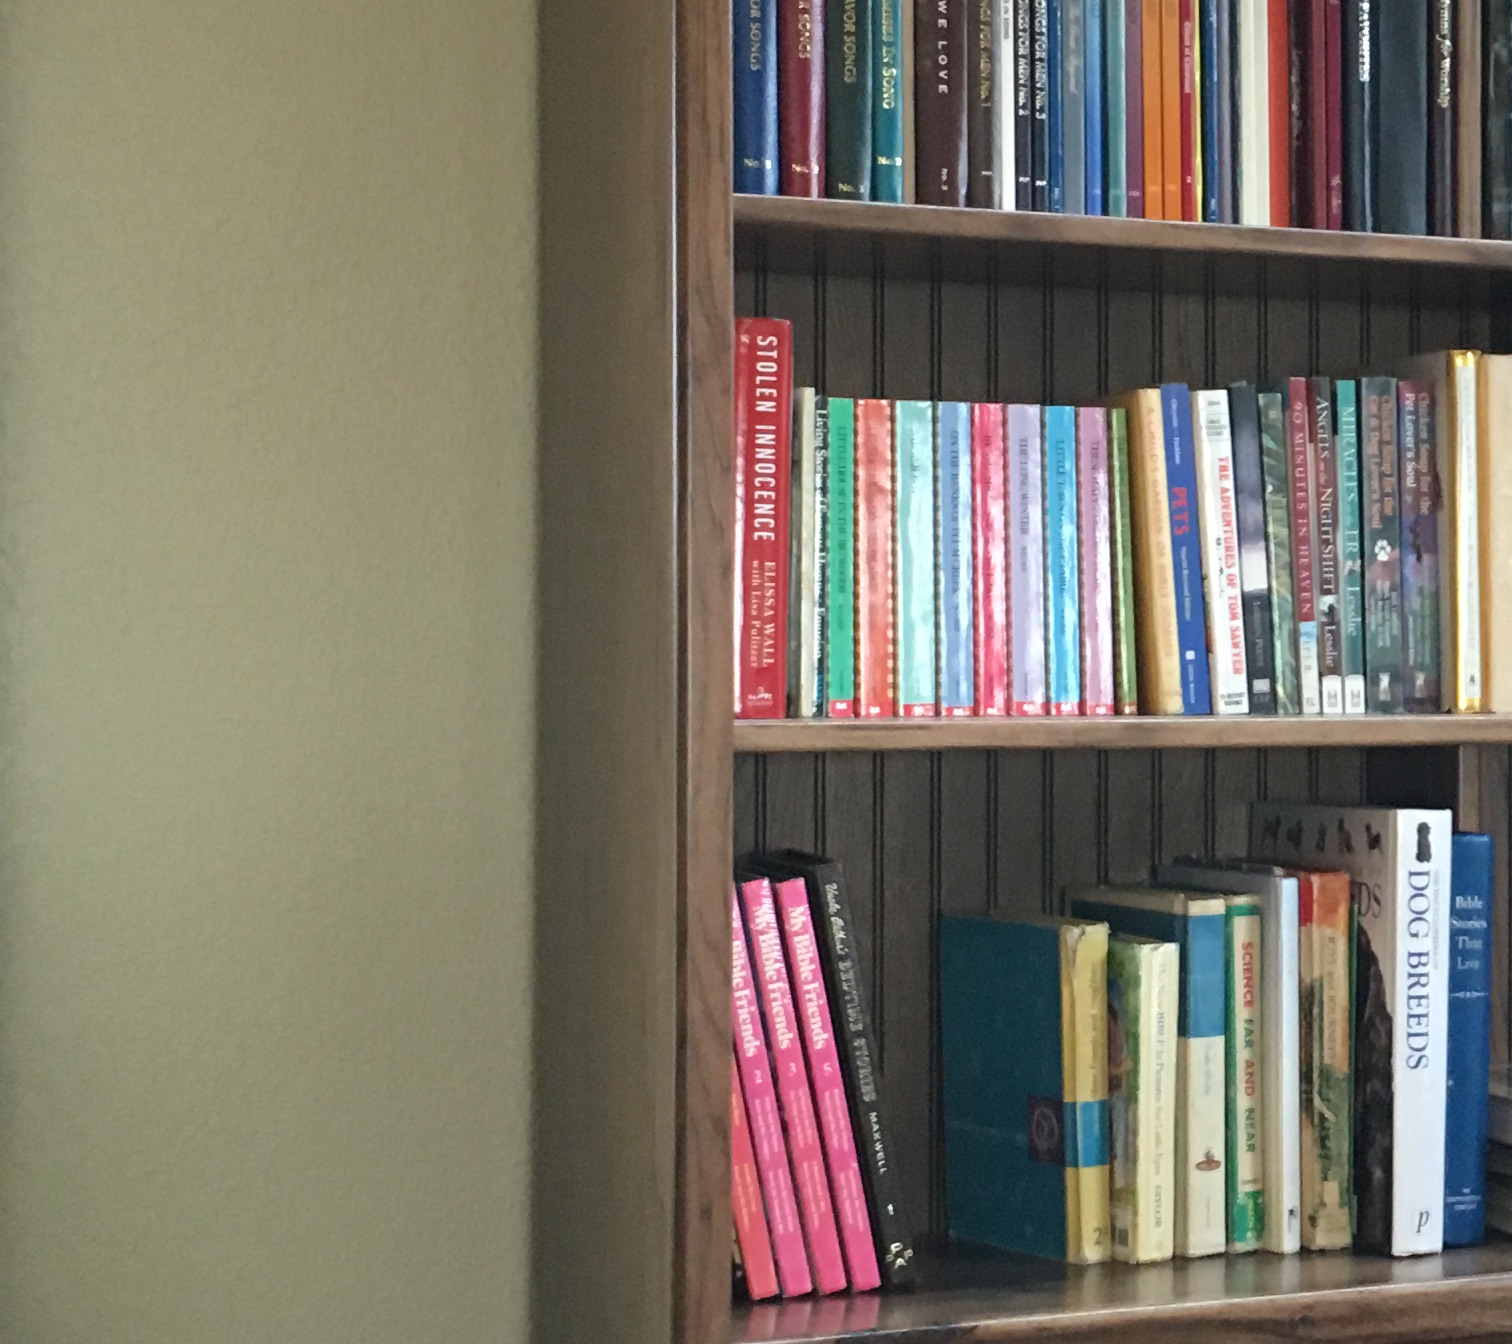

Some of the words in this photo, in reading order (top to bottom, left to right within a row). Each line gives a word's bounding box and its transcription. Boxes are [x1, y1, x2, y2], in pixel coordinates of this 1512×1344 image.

[796, 13, 811, 59] SONGS
[936, 0, 948, 28] WE
[980, 23, 991, 48] FOR
[748, 22, 762, 71] SONGS
[842, 35, 857, 84] SONGS
[981, 51, 992, 78] MEN
[1018, 31, 1030, 56] FOR
[1035, 35, 1047, 59] FOR
[882, 66, 897, 110] SONG
[936, 40, 949, 94] LOVE
[1018, 58, 1030, 85] MEN
[1035, 61, 1047, 88] MEN
[1437, 57, 1451, 109] Worship
[755, 335, 779, 414] STOLEN
[1292, 401, 1305, 424] 90
[1404, 392, 1417, 411] Pet
[814, 409, 828, 447] Living
[1315, 397, 1331, 459] ANGELS
[1404, 415, 1417, 459] Lover's
[1217, 456, 1231, 482] THE
[1293, 431, 1309, 511] MINUTES
[1341, 406, 1357, 503] MIRACLES
[1405, 460, 1418, 488] Soul
[752, 424, 777, 542] INNOCENCE
[1419, 476, 1432, 493] for
[1019, 492, 1031, 536] WINTER
[1172, 486, 1190, 536] PETS
[1219, 485, 1237, 569] ADVENTURES
[1297, 517, 1309, 537] IN
[1318, 487, 1335, 543] NIGHT
[1419, 496, 1432, 516] the
[1344, 528, 1360, 554] ER
[750, 559, 762, 587] with
[763, 560, 776, 617] ELISSA
[1225, 572, 1239, 588] OF
[1298, 544, 1312, 614] HEAVEN
[1321, 543, 1336, 593] SHIFT
[751, 590, 762, 616] Lisa
[1227, 593, 1240, 621] TOM
[763, 622, 776, 668] WALL
[1230, 625, 1244, 675] SAWYER
[1324, 624, 1338, 669] Lesslie
[747, 904, 771, 933] My
[784, 905, 810, 934] My
[1407, 869, 1432, 940] DOG
[1455, 895, 1484, 909] Bible
[756, 933, 781, 981] Bible
[791, 934, 819, 983] Bible
[1240, 940, 1255, 1008] SCIENCE
[737, 986, 761, 1058] Friends
[767, 982, 794, 1050] Friends
[802, 983, 829, 1050] Friends
[824, 882, 842, 915] Uncle
[838, 958, 864, 1033] BEDTIME
[853, 1038, 877, 1103] STORIES
[868, 1111, 888, 1175] MAXWELL
[1406, 950, 1432, 1071] BREEDS
[1242, 1018, 1255, 1049] FAR
[1243, 1058, 1257, 1097] AND
[1243, 1107, 1257, 1154] NEAR
